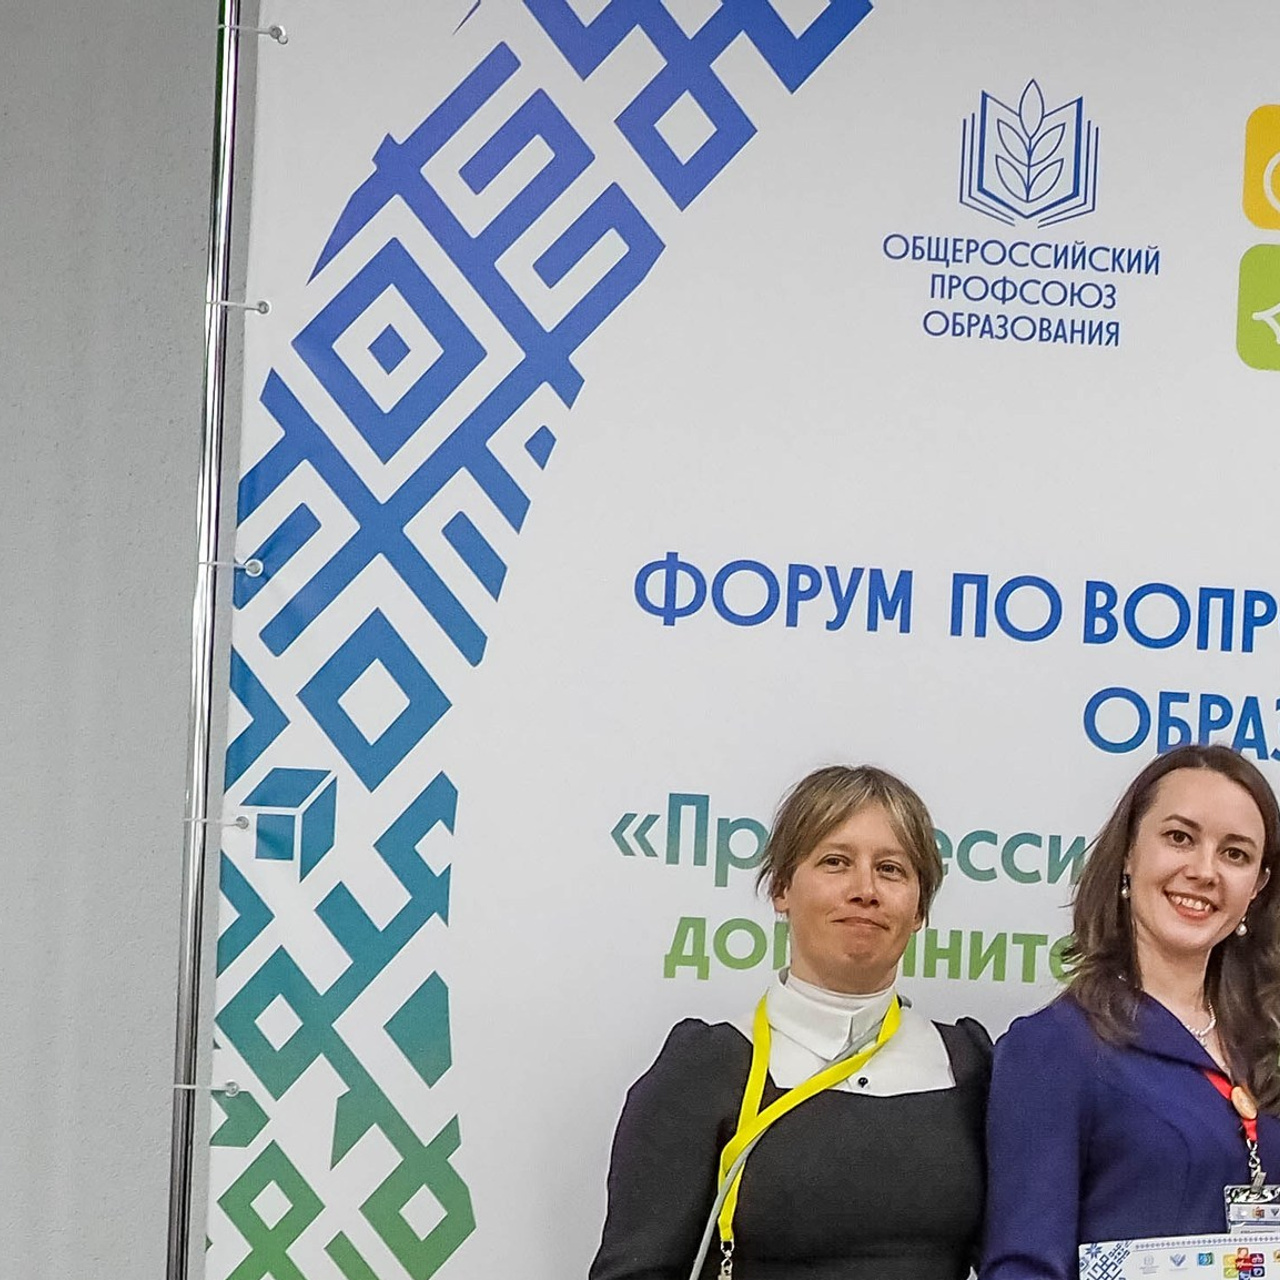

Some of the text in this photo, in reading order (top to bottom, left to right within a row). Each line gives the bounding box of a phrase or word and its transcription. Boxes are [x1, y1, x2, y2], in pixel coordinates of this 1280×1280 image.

[883, 234, 1161, 276] ОБЩЕРОССИЙСКИЙ
[930, 273, 1117, 310] ПРОФСОЮЗ
[923, 311, 1120, 347] ОБРАЗОВАНИЯ
[634, 551, 914, 634] ФОРУМ
[950, 572, 1063, 643] ПО
